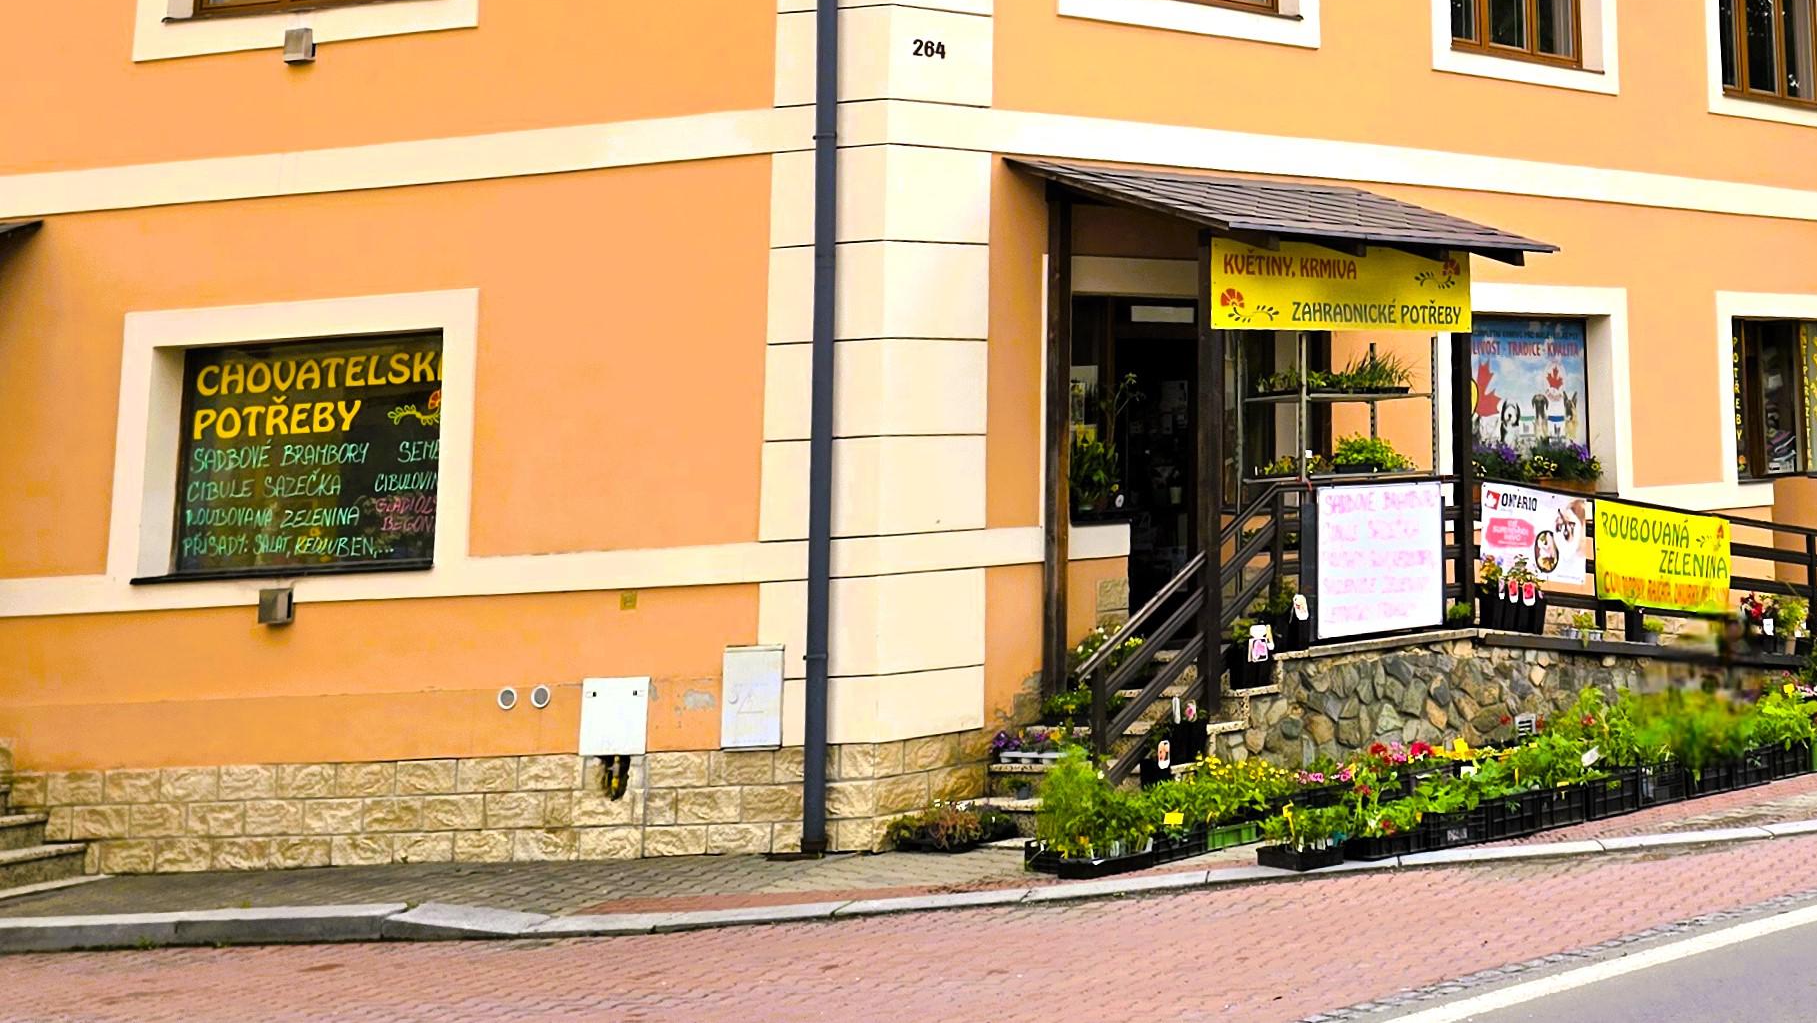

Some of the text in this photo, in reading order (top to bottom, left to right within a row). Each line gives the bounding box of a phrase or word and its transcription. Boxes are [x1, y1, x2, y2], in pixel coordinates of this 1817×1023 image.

[913, 39, 945, 59] 264
[1224, 249, 1357, 280] KVĚTINY, KRMIVA
[1292, 298, 1462, 325] ZAHRADNICKÉ POTŘEBY
[193, 395, 361, 440] POTŘEBY
[193, 439, 369, 473] SADBOVÉ BRAMBORY
[187, 469, 341, 502] CIBULE SAZEČKA
[1501, 493, 1538, 511] ONTARIO
[280, 506, 360, 529] ZELENINA
[1601, 512, 1690, 548] ROUBOVANÁ
[1658, 550, 1728, 579] ZELENINA
